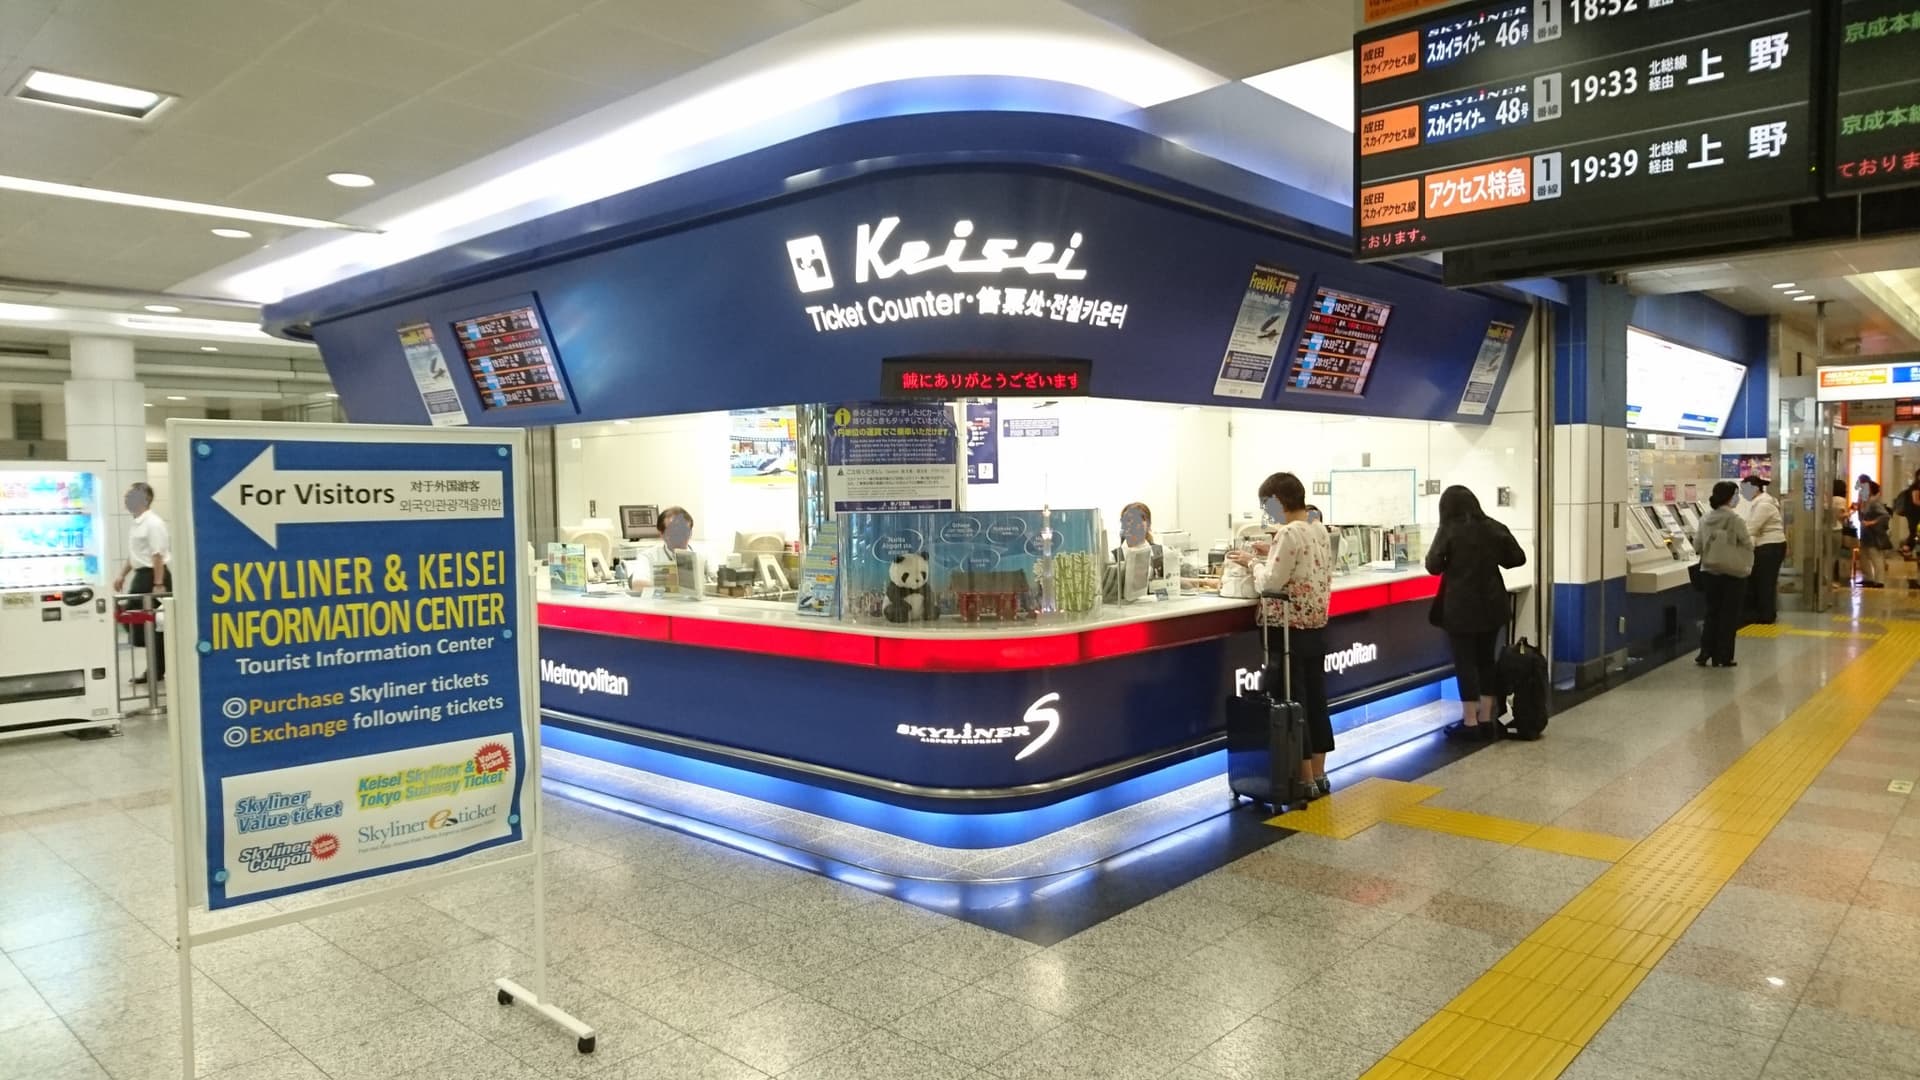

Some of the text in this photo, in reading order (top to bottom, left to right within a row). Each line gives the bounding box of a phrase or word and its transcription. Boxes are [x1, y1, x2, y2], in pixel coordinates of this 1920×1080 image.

[1427, 20, 1529, 64] スカイライナー 46号
[1537, 24, 1559, 39] 番線
[1363, 46, 1384, 61] 成田
[1363, 53, 1417, 76] スカイアクセス線
[1648, 55, 1687, 75] 北総線
[1541, 79, 1551, 103] 1
[1570, 66, 1638, 105] 19:33
[1648, 75, 1674, 92] 経由
[1427, 97, 1529, 138] スカイライナー 48号
[1537, 104, 1559, 119] 番線
[1363, 119, 1384, 133] 成田
[1363, 126, 1417, 149] スカイアクセス線
[1648, 139, 1687, 159] 北総線
[1541, 158, 1551, 182] 1
[1570, 149, 1638, 185] 19:39
[1648, 159, 1674, 175] 経由
[1363, 191, 1384, 205] 成田
[1429, 167, 1527, 209] アクセス特急
[1537, 184, 1559, 198] 番線
[1363, 201, 1417, 221] スカイアクセス線
[855, 215, 1088, 283] Keisei
[806, 301, 864, 333] Ticket
[872, 288, 965, 325] Counter
[240, 482, 395, 506] For Visitors
[410, 480, 480, 494] 对于外国游客
[400, 498, 503, 513] 외국인관광객을위한
[211, 551, 506, 605] SKYLINER & KEISEI
[211, 592, 506, 651] INFORMATION CENTER
[235, 635, 495, 676] Tourist Information Center
[540, 658, 629, 697] Metropolitan
[1235, 667, 1262, 697] For
[249, 672, 489, 716] Purchase Skyliner tickets
[249, 695, 504, 745] Exchange following tickets
[358, 760, 475, 793] Keisei Skyliner &
[359, 770, 504, 808] Tokyo Subway Ticket
[235, 791, 311, 815] Skyliner
[237, 801, 343, 834] Value ticket
[357, 820, 429, 845] Skyliner
[459, 804, 497, 822] ticket
[239, 841, 311, 863] Skyliner
[248, 852, 312, 873] Coupon
